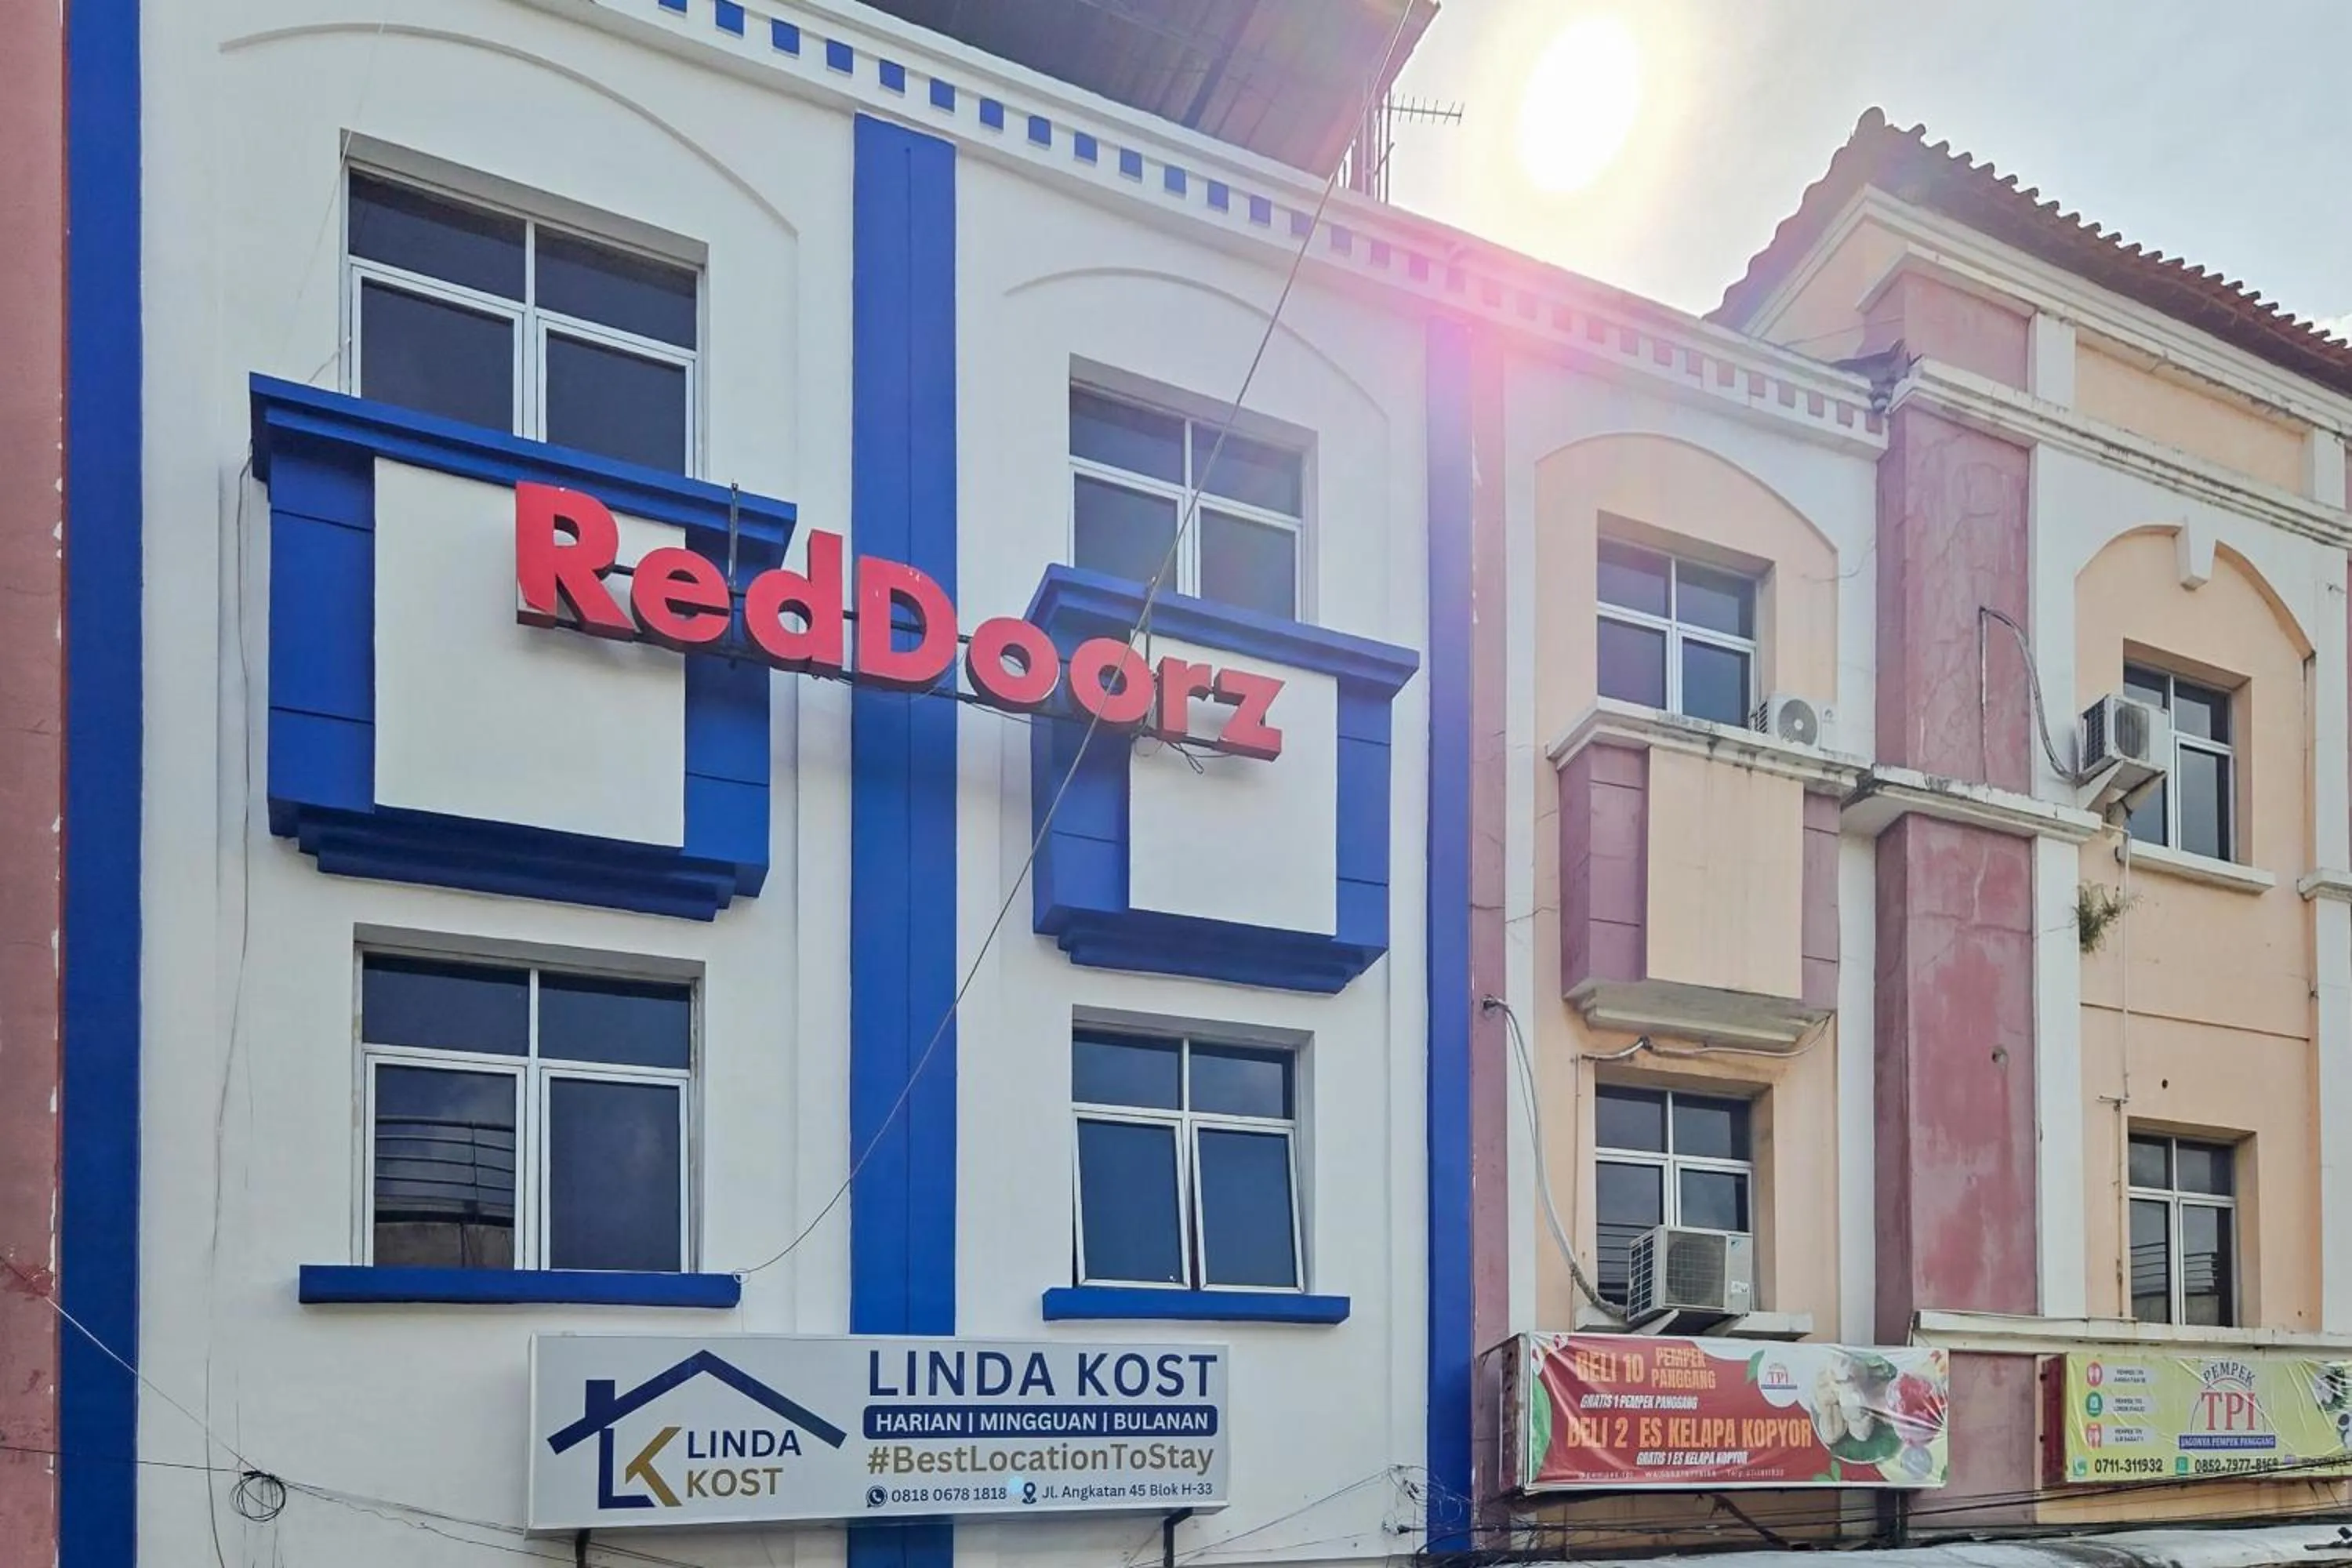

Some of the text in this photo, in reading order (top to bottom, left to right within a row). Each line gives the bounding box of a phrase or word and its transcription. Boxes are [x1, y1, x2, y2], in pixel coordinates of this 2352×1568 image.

[515, 481, 1284, 761] RedDoorz
[1575, 1351, 1645, 1383] BELI 10
[1655, 1347, 1706, 1368] PEMPEK
[869, 1350, 1218, 1397] LINDA KOST
[1651, 1367, 1716, 1389] PANGGANG
[2202, 1362, 2256, 1390] PEMPEK
[1580, 1394, 1612, 1409] GRATIS
[1620, 1395, 1654, 1409] PEMPEK
[2201, 1392, 2256, 1431] TPI
[876, 1412, 961, 1432] HARIAN
[980, 1412, 1097, 1432] MINGGUAN
[1114, 1411, 1208, 1431] BULANAN
[1568, 1417, 1812, 1448] BELI 2 ES KELAPA KOPYOR
[687, 1429, 801, 1459] LINDA
[1672, 1452, 1684, 1465] ES
[867, 1443, 1214, 1475] #BestLocationToStay
[2094, 1457, 2163, 1474] 0711-311932
[687, 1467, 783, 1498] KOST
[891, 1483, 1214, 1503] 0818 0678 1818 Jl. Angkatan 45 Blok H-33
